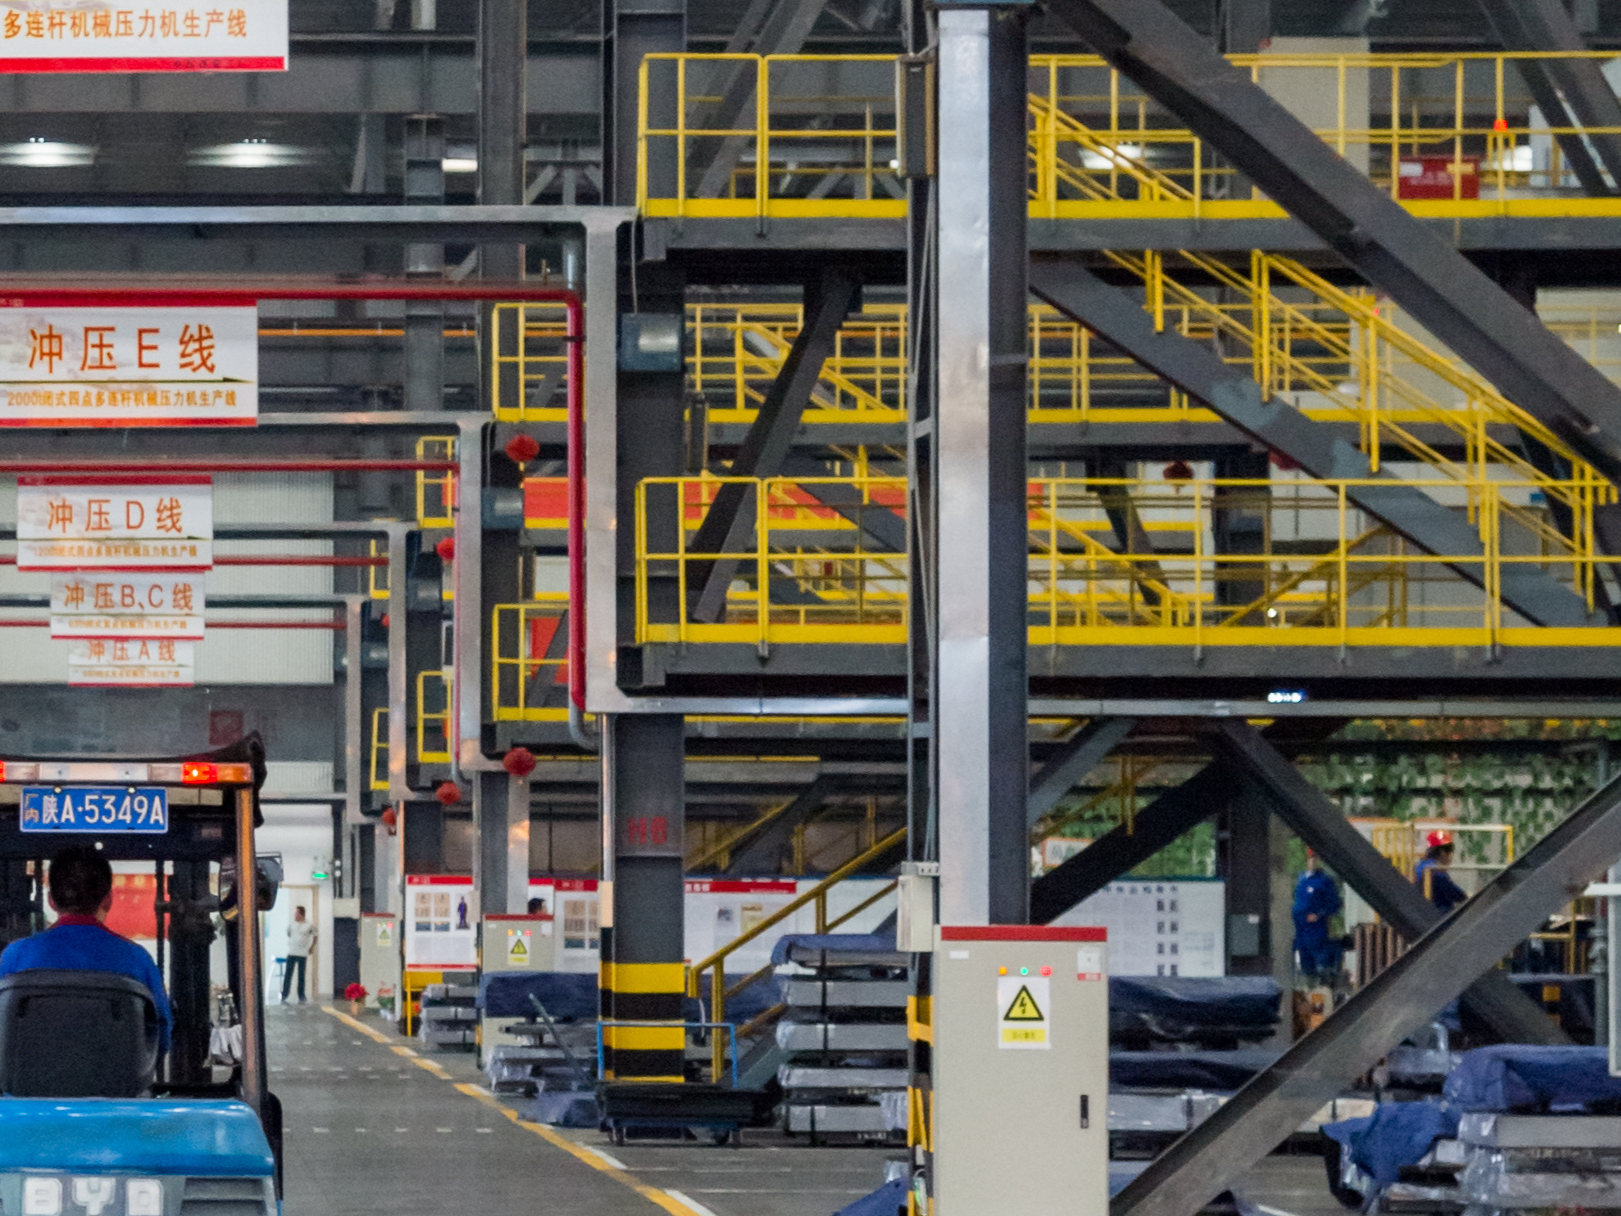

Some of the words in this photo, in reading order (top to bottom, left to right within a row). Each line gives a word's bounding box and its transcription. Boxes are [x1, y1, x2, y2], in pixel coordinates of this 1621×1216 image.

[28, 323, 217, 373] 冲压E线
[47, 497, 183, 533] 冲压D线
